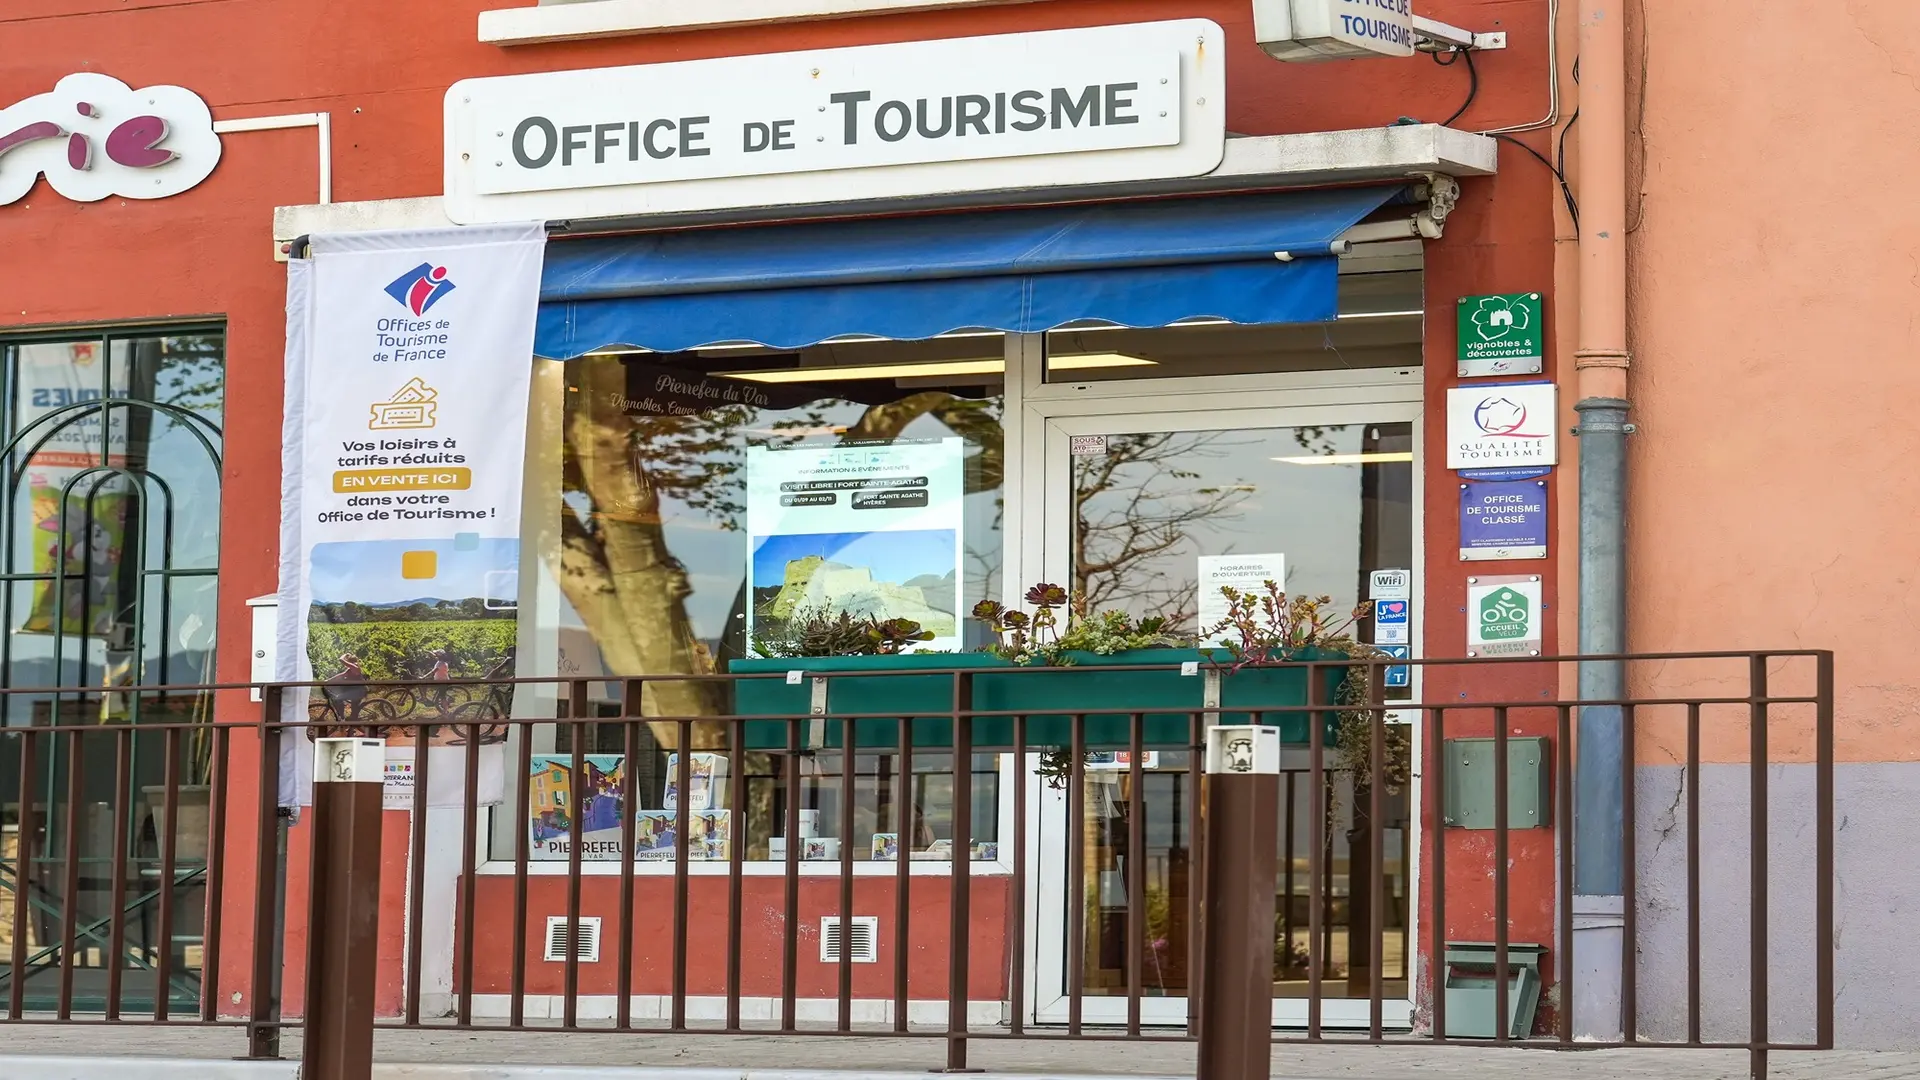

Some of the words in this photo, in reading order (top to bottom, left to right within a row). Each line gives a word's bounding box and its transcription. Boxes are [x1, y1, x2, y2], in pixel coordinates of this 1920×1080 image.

[1340, 15, 1412, 48] TOURISME
[512, 116, 711, 169] OFFICE
[743, 119, 796, 153] DE
[830, 82, 1139, 145] TOURISME
[377, 318, 431, 332] Offices
[435, 320, 450, 329] de
[376, 333, 448, 347] Tourisme
[1466, 341, 1521, 351] vignobles
[372, 352, 389, 362] de
[394, 349, 447, 362] France
[1466, 348, 1532, 358] découvertes
[655, 374, 719, 399] Pierrefeu
[723, 384, 740, 402] du
[743, 386, 770, 406] Var
[611, 392, 664, 414] Vignobles,
[342, 441, 375, 452] Vos
[380, 439, 439, 451] loisirs
[443, 437, 457, 449] à
[1460, 439, 1543, 451] QUALITÉ
[337, 454, 389, 466] tarifs
[393, 453, 466, 465] réduits
[1460, 449, 1543, 459] TOURISME
[342, 477, 365, 487] EN
[368, 474, 429, 486] VENTE
[432, 474, 458, 484] ICI
[347, 495, 392, 507] dans
[396, 493, 450, 505] votre
[1483, 495, 1523, 504] OFFICE
[318, 511, 364, 523] Office
[367, 509, 389, 521] de
[393, 507, 487, 520] Tourisme
[490, 507, 496, 518] !
[1466, 507, 1482, 515] DE
[1484, 504, 1541, 514] TOURISME
[1481, 513, 1526, 524] CLASSÉ
[1485, 623, 1521, 632] ACCUEIL
[1482, 642, 1529, 650] BIENVENUE
[1393, 673, 1404, 683] T
[549, 841, 622, 854] PIEREFEU
